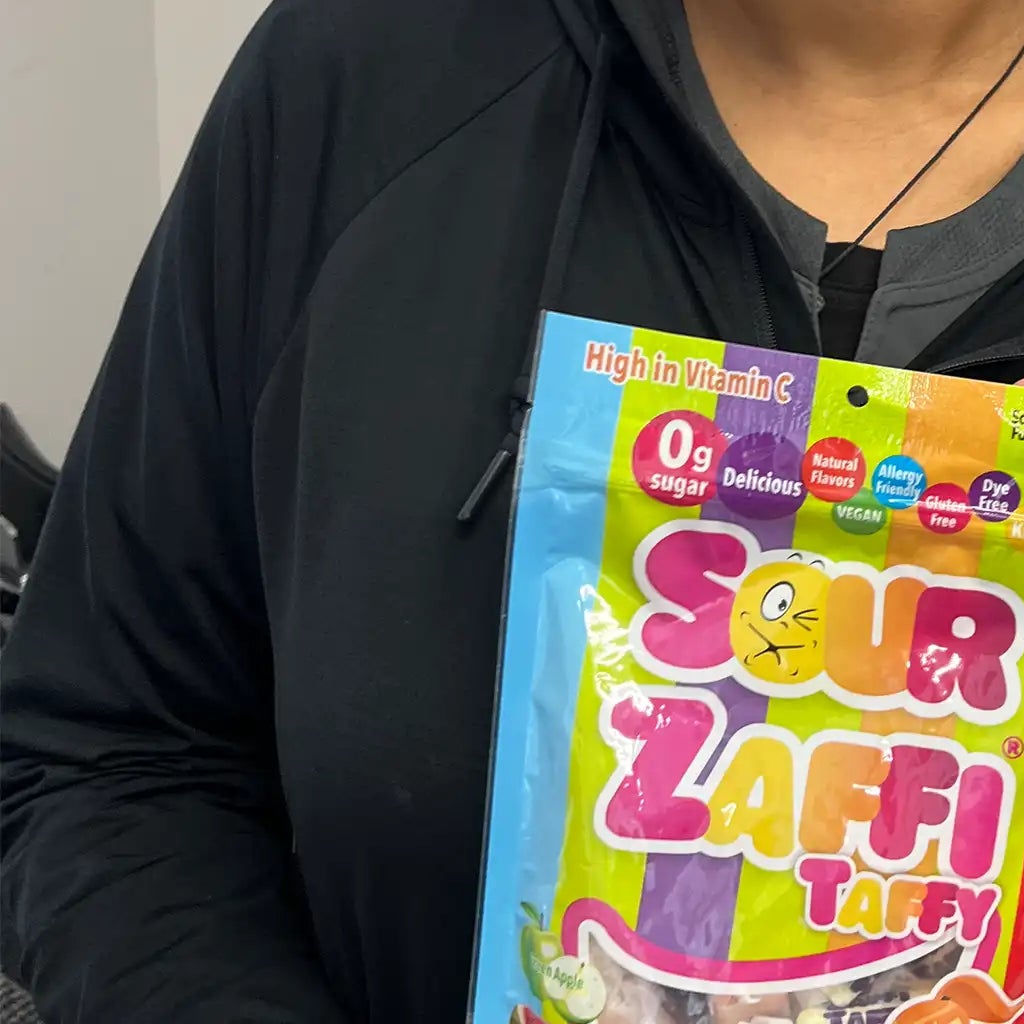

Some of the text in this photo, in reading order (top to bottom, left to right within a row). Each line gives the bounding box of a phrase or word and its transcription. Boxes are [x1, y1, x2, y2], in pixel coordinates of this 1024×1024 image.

[584, 340, 794, 404] High in Vitamin C
[658, 418, 714, 473] 0g
[812, 453, 859, 472] Natural
[649, 473, 710, 499] sugar
[722, 466, 804, 498] Delicious
[810, 469, 855, 489] Flavors
[878, 464, 924, 486] Allergy
[875, 480, 922, 502] Friendly
[981, 478, 1011, 497] Dye
[836, 504, 882, 522] VEGAN
[925, 495, 968, 514] Gluten
[978, 495, 1009, 513] Free
[930, 512, 957, 528] Free
[596, 685, 1014, 882] ZAFFI
[796, 855, 1000, 944] TAFFY
[553, 966, 584, 991] Apple
